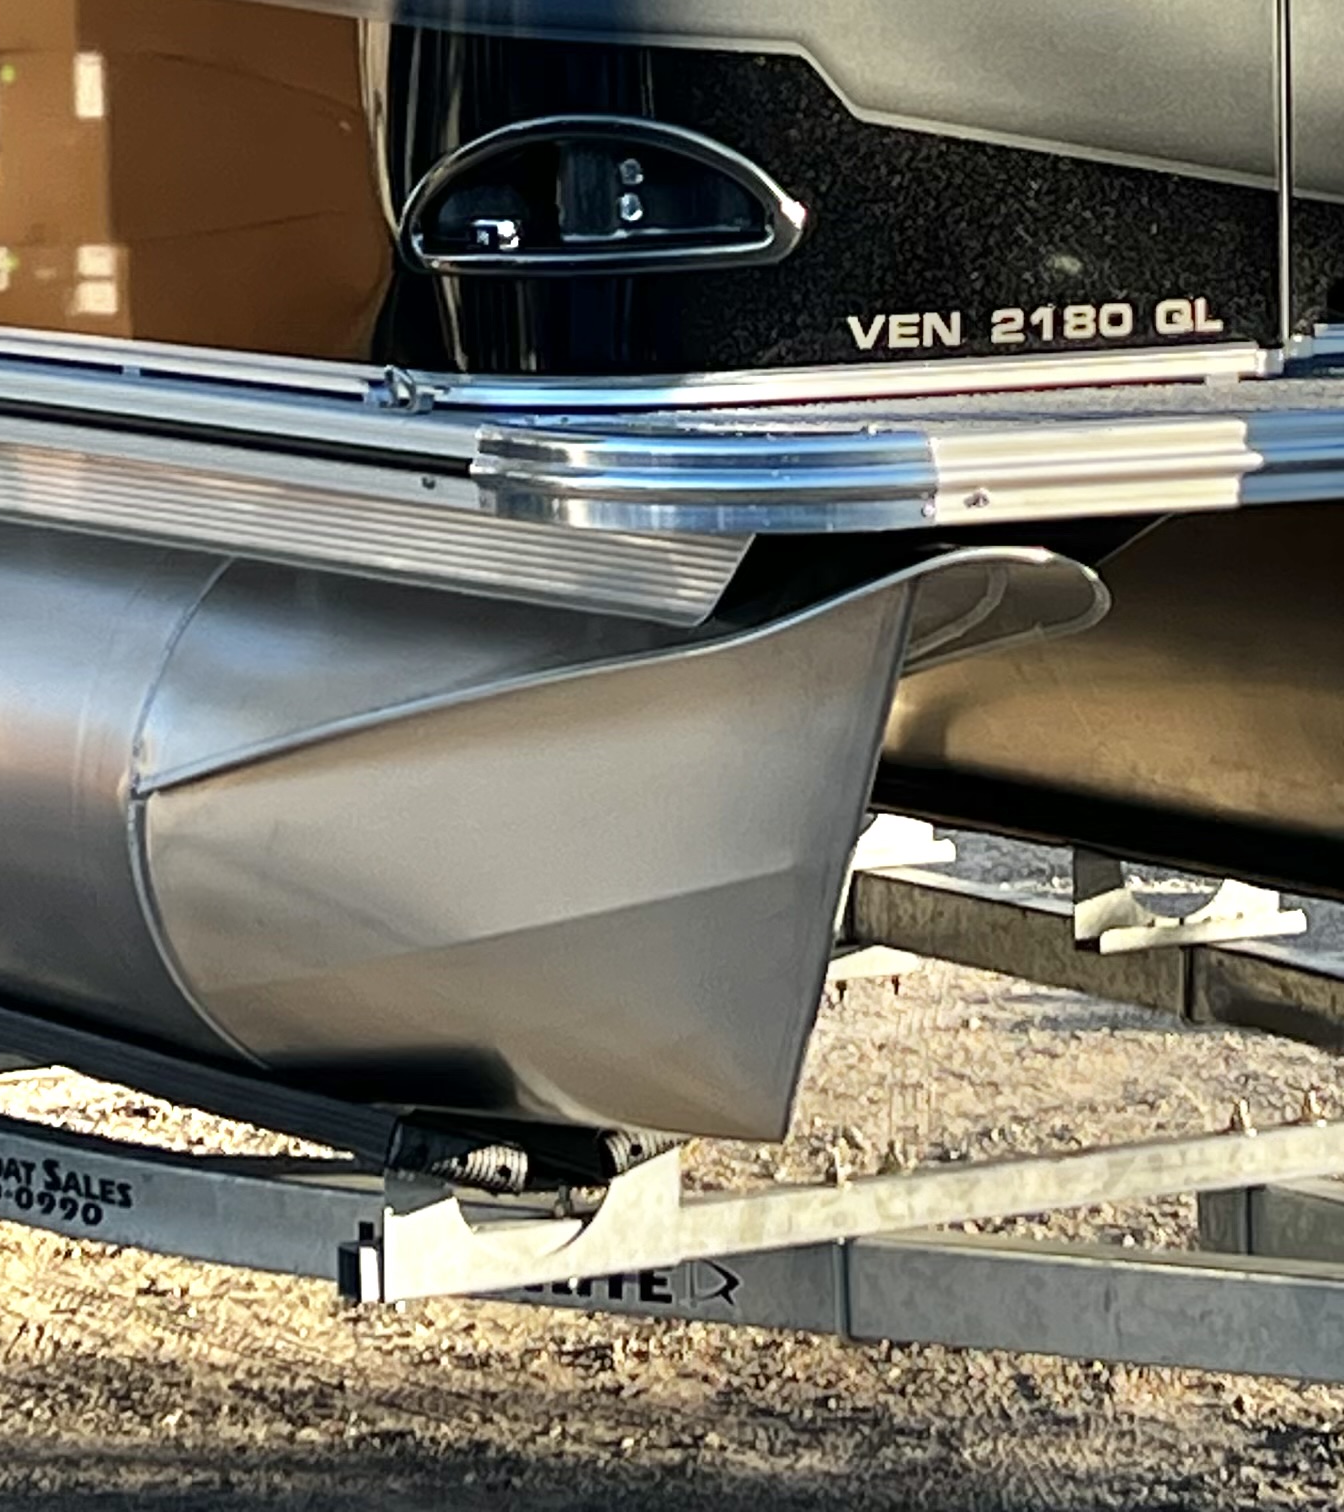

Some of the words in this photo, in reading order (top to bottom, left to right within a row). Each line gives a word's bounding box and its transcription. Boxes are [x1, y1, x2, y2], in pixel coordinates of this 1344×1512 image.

[847, 311, 962, 350] VEN
[990, 302, 1134, 344] 2180
[42, 1158, 133, 1209] SALES
